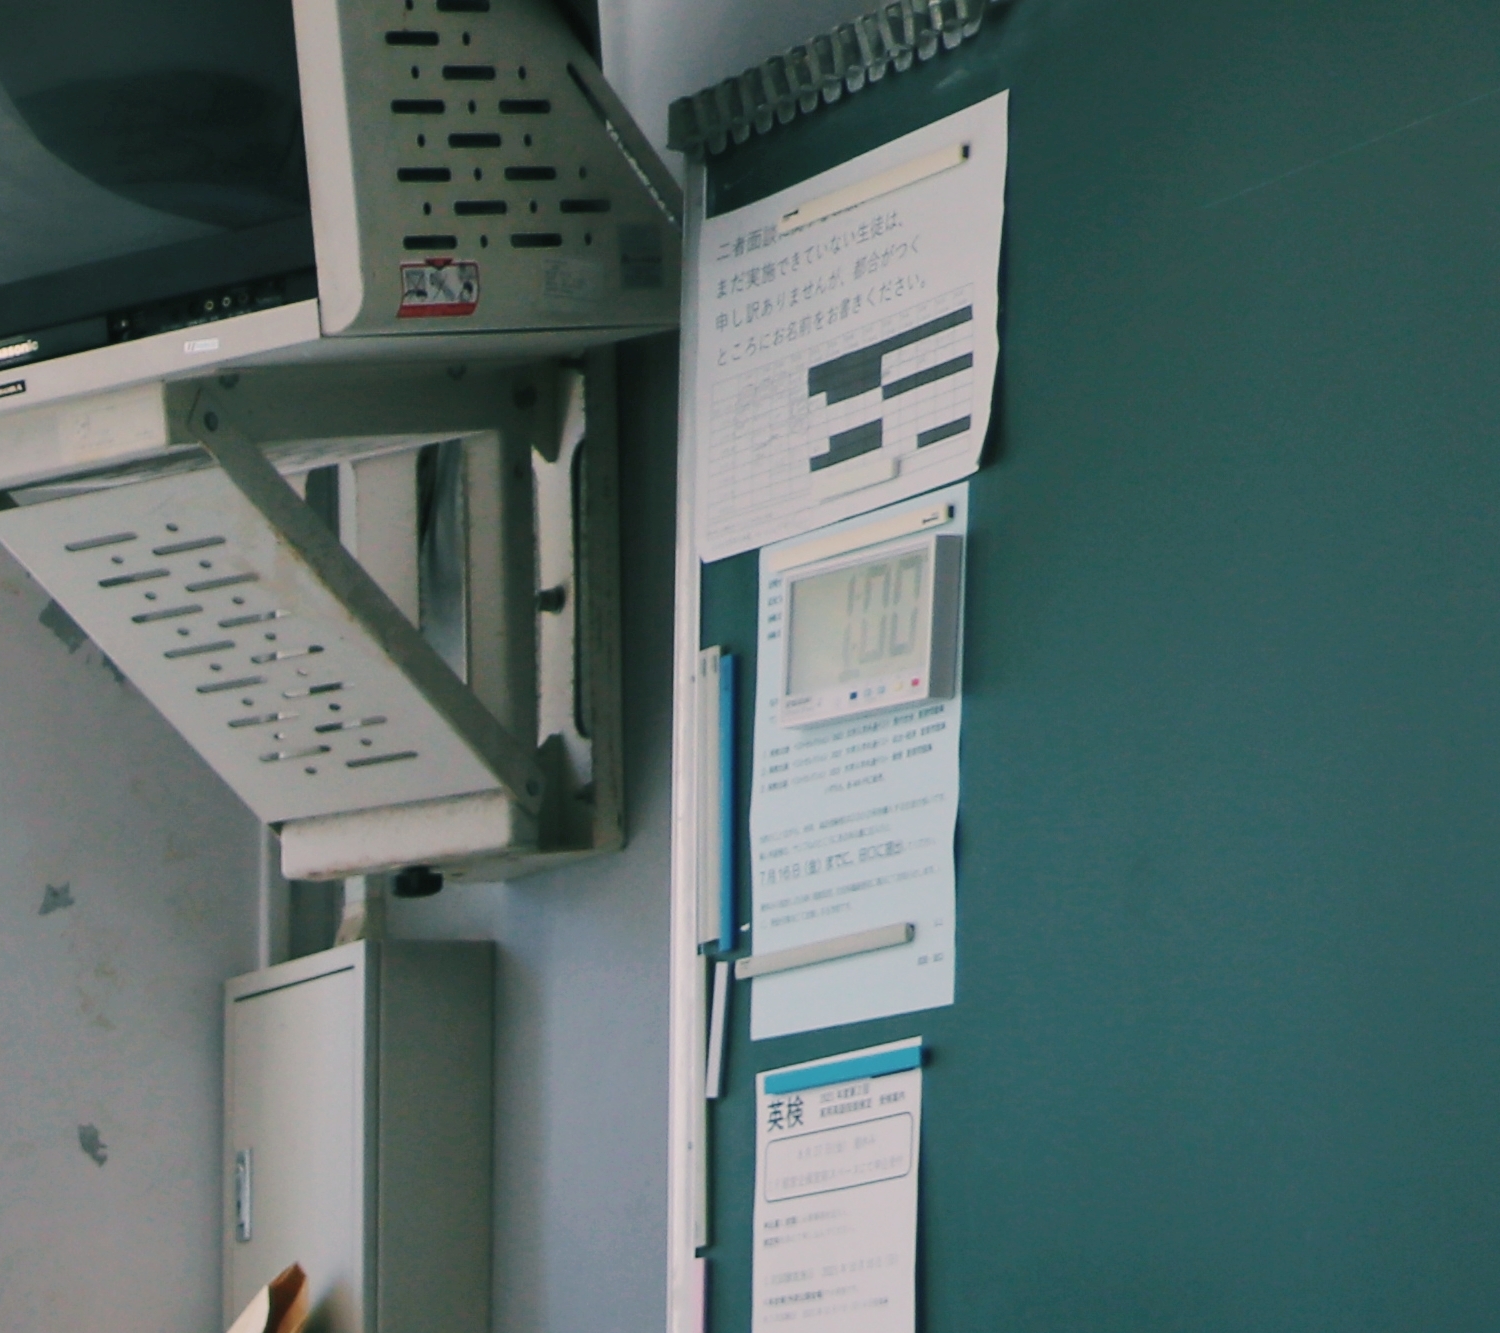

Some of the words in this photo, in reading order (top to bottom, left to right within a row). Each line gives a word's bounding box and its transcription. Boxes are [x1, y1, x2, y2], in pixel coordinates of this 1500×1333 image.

[716, 234, 920, 332] 申し訳ありませんが、都合がつく
[717, 212, 902, 299] まだ実施できていない生徒は、
[717, 273, 926, 366] ところにお名前をお書きください。
[767, 1095, 804, 1133] 英検
